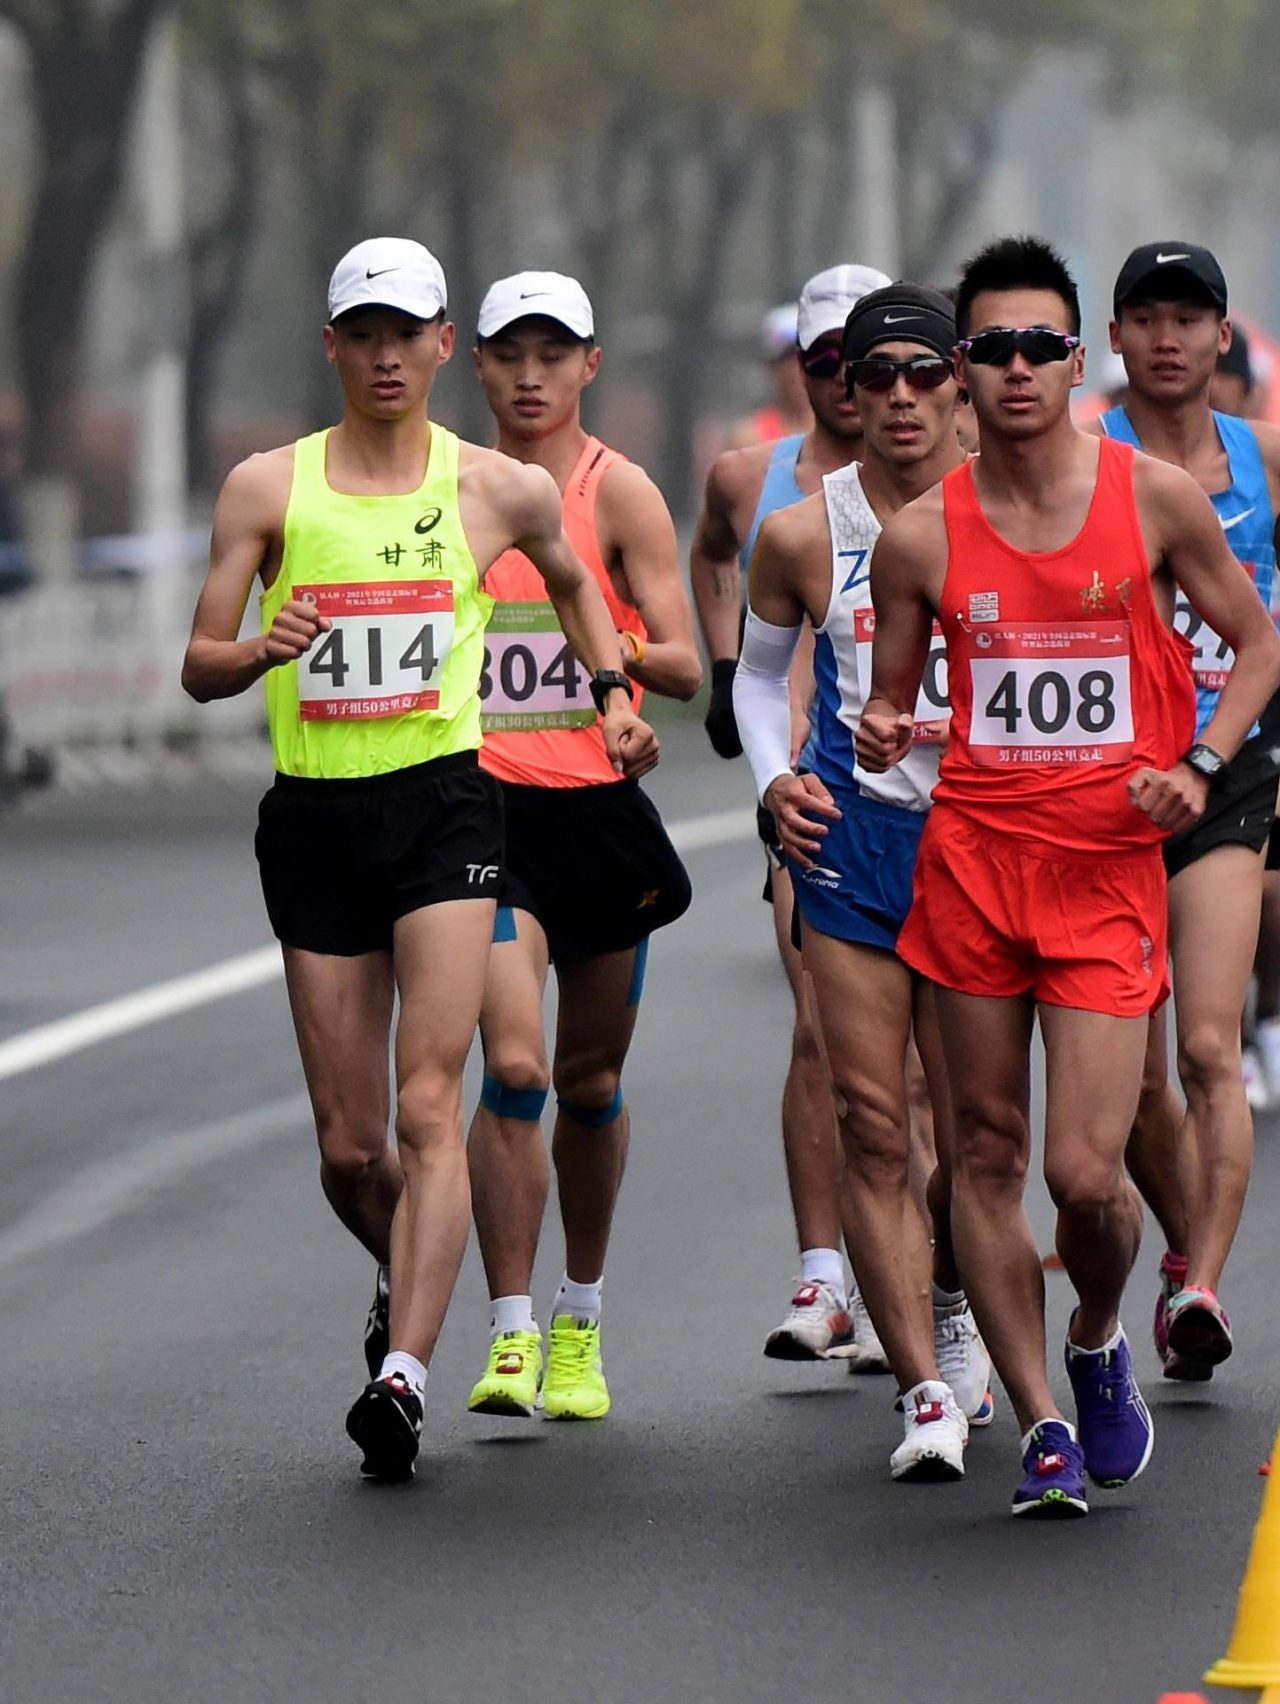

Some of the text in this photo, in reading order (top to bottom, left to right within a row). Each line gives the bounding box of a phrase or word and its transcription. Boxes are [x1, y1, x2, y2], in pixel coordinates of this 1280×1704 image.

[376, 538, 447, 570] 甘肃
[309, 623, 439, 687] 414
[985, 670, 1116, 734] 408
[998, 748, 1104, 763] 男子组50公里竞走
